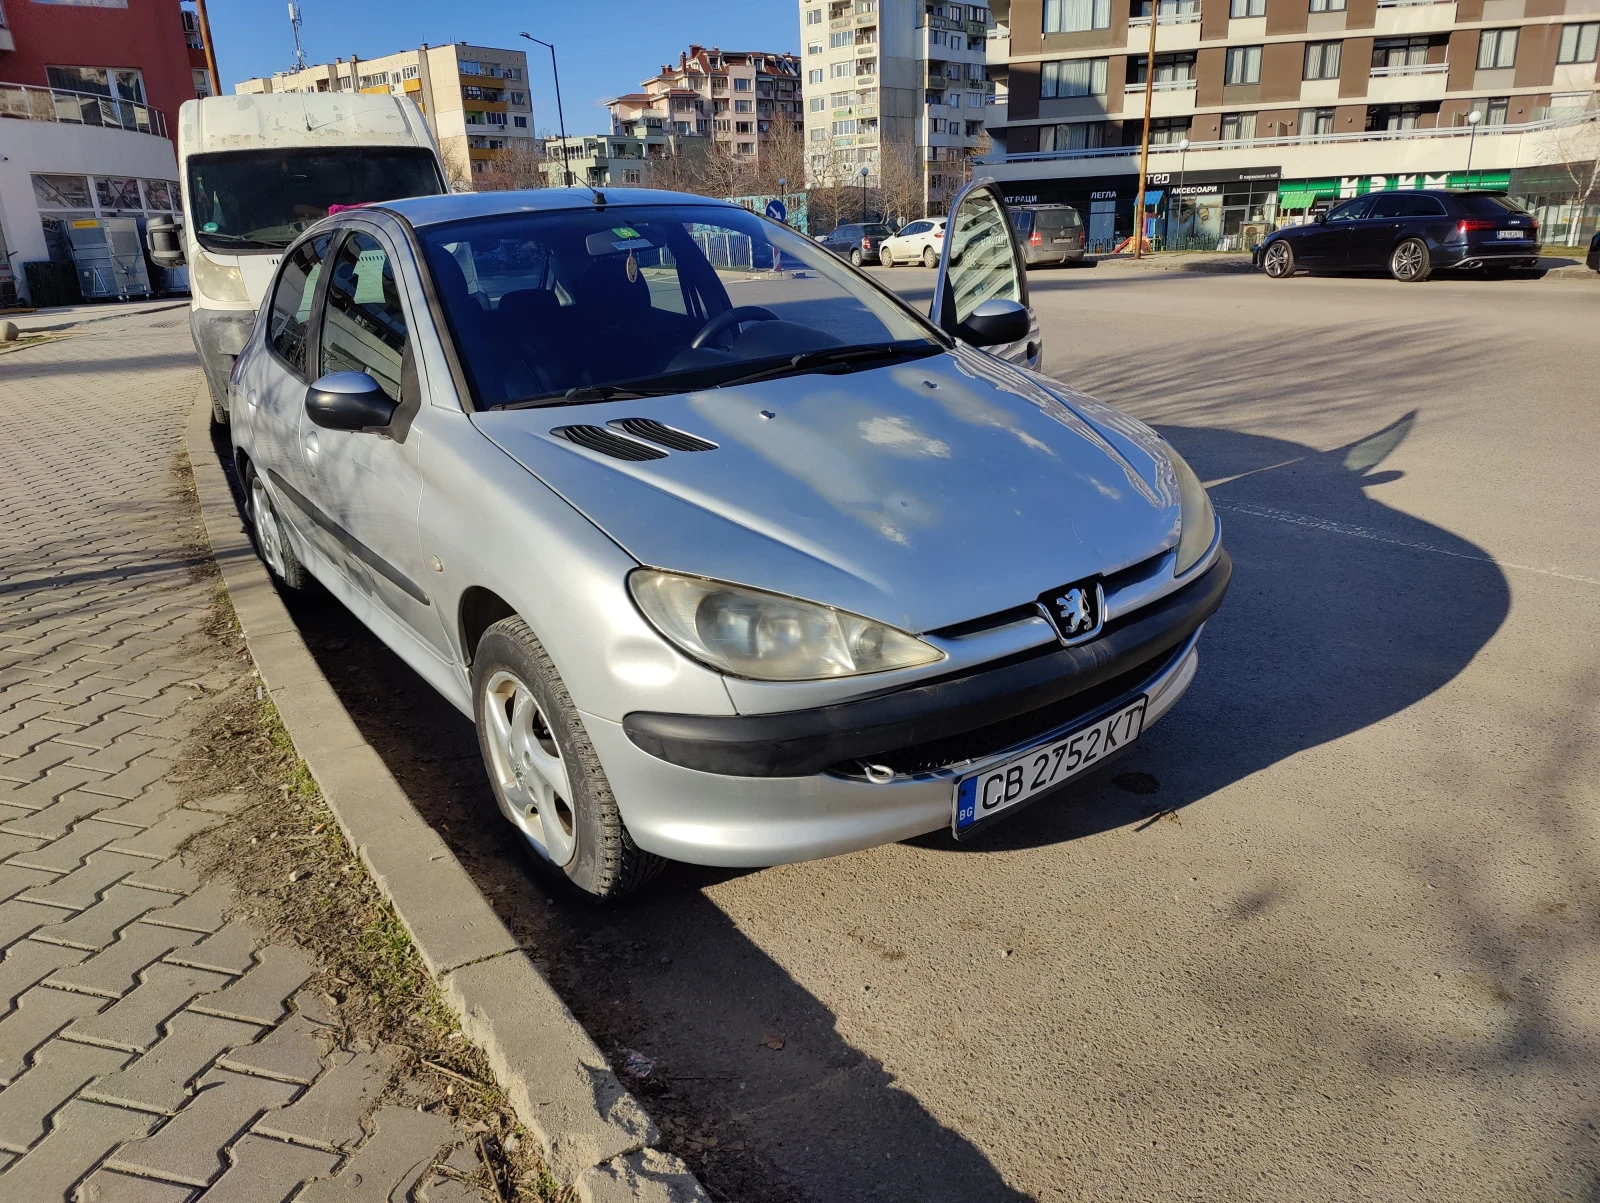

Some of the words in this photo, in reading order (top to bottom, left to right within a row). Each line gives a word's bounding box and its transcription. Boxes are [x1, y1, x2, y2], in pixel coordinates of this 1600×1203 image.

[1090, 190, 1117, 199] ЛЕГЛА
[1171, 185, 1218, 195] АКСЕСОАРИ
[1004, 195, 1037, 204] АТРАЦИ
[959, 806, 974, 821] BG
